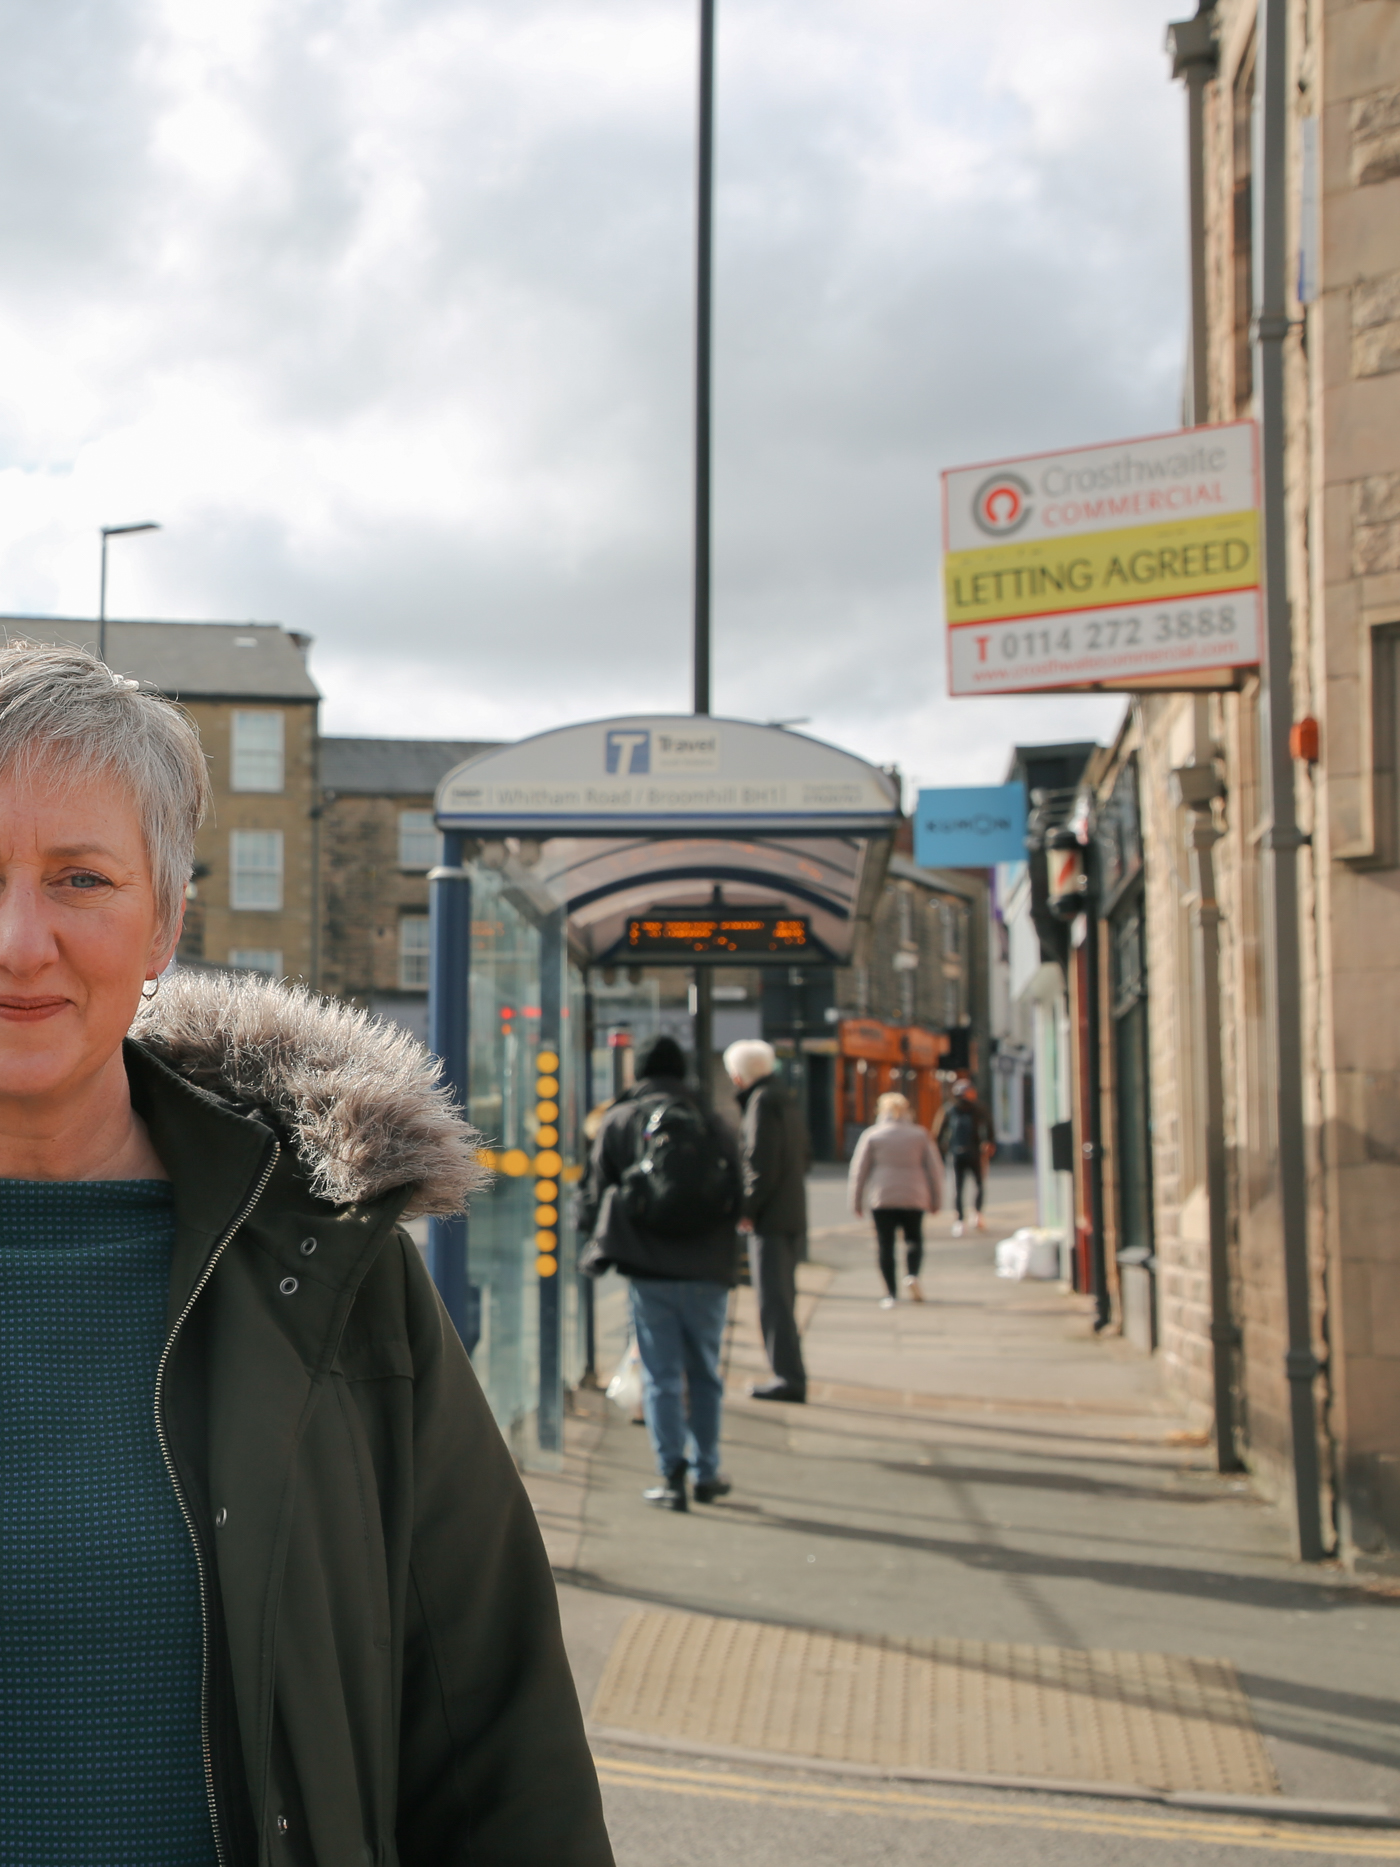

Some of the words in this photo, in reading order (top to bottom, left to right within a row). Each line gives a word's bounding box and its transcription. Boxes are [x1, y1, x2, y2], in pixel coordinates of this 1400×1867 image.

[1041, 445, 1227, 498] Crosthwaite
[1041, 482, 1225, 529] COMMERCIAL
[953, 558, 1093, 608] LETTING
[1103, 538, 1250, 587] AGREED
[973, 635, 990, 663] T
[1002, 627, 1072, 660] 0114
[1086, 617, 1141, 651] 272
[1156, 606, 1236, 643] 3888
[660, 735, 716, 754] Travel
[586, 787, 631, 804] Road
[649, 786, 736, 804] Broomhill
